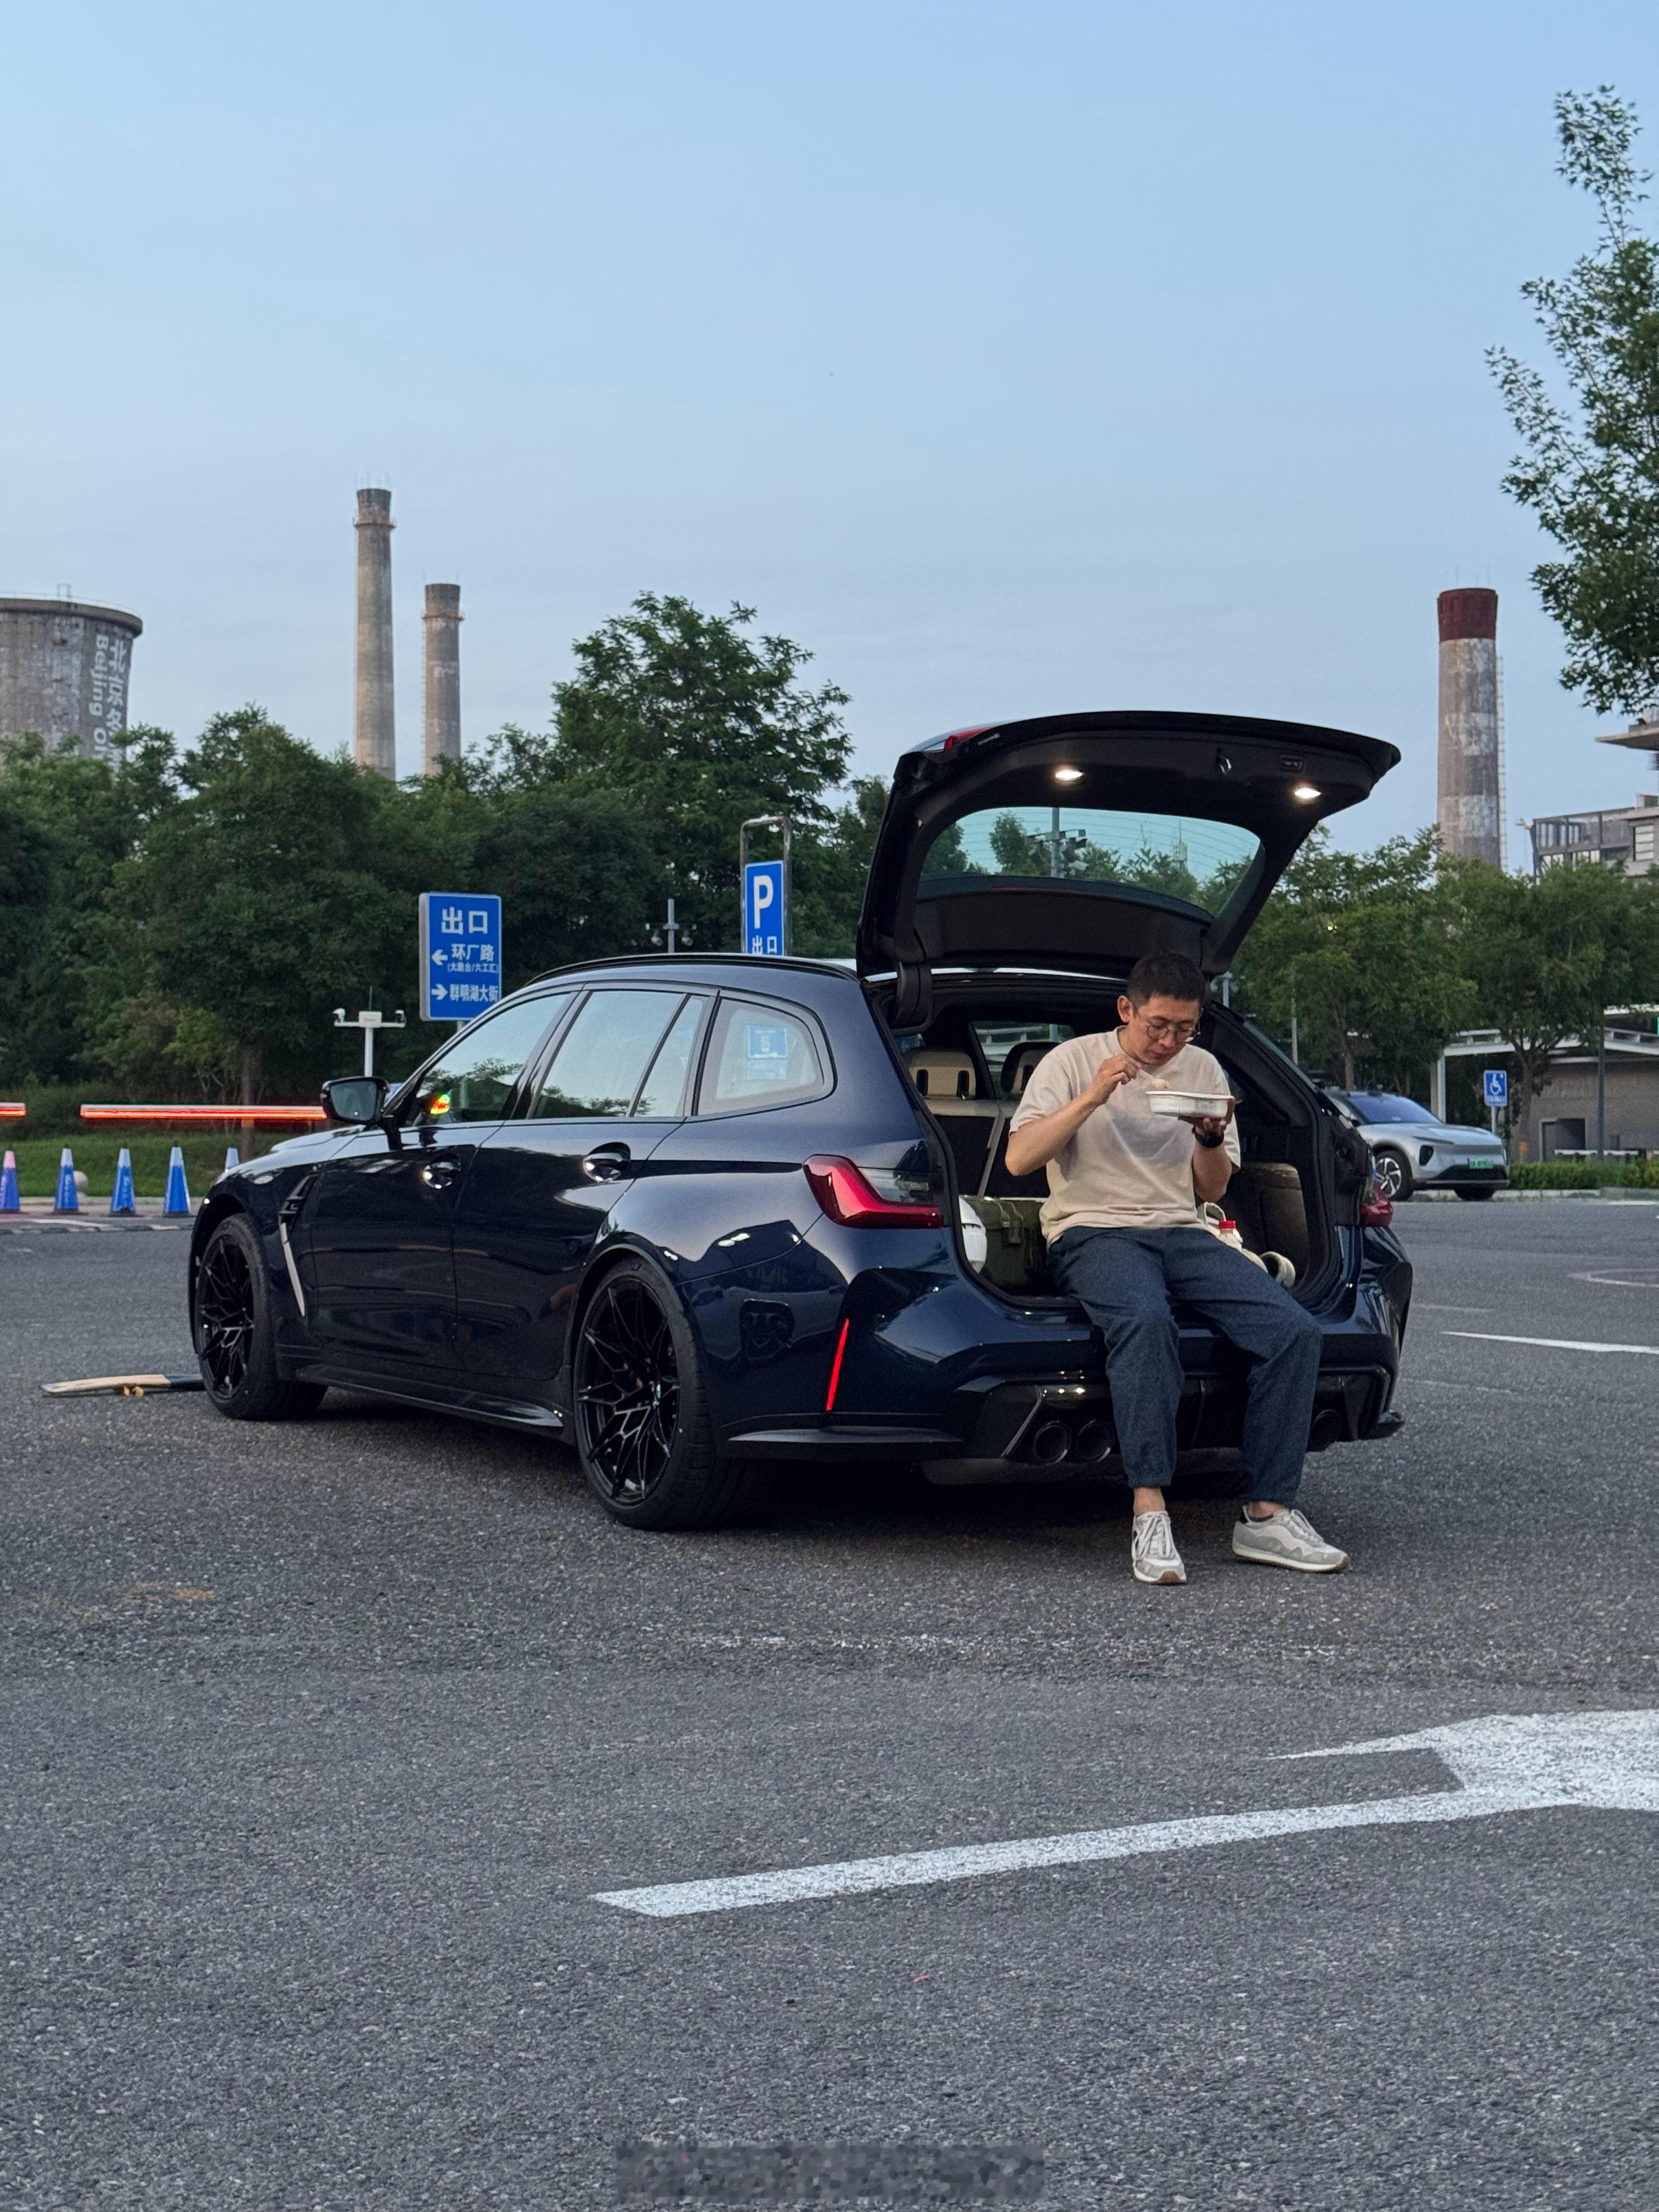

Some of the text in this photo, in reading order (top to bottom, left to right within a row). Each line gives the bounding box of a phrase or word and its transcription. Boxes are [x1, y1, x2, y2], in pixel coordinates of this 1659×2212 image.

[89, 634, 109, 716] Beijing
[753, 875, 774, 929] P
[441, 906, 488, 935] 出口
[451, 943, 495, 962] 环厂路
[752, 935, 777, 955] 出口
